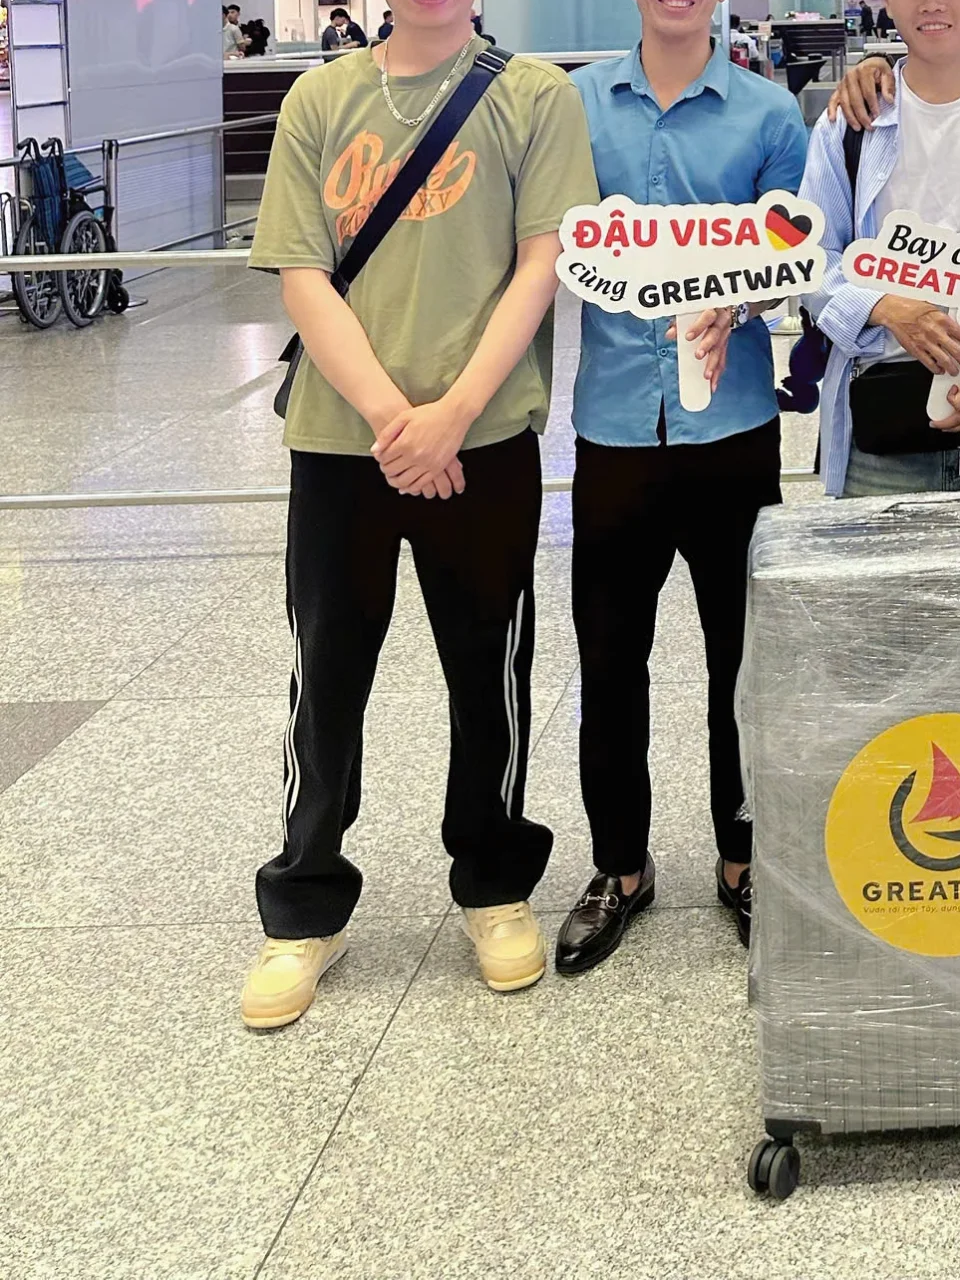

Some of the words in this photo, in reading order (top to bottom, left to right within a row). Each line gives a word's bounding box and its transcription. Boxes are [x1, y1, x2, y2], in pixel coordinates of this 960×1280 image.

[572, 209, 658, 257] ĐẬU
[670, 218, 760, 247] VISA
[887, 224, 946, 264] Bay
[568, 262, 628, 302] cùng
[637, 258, 814, 308] GREATWAY
